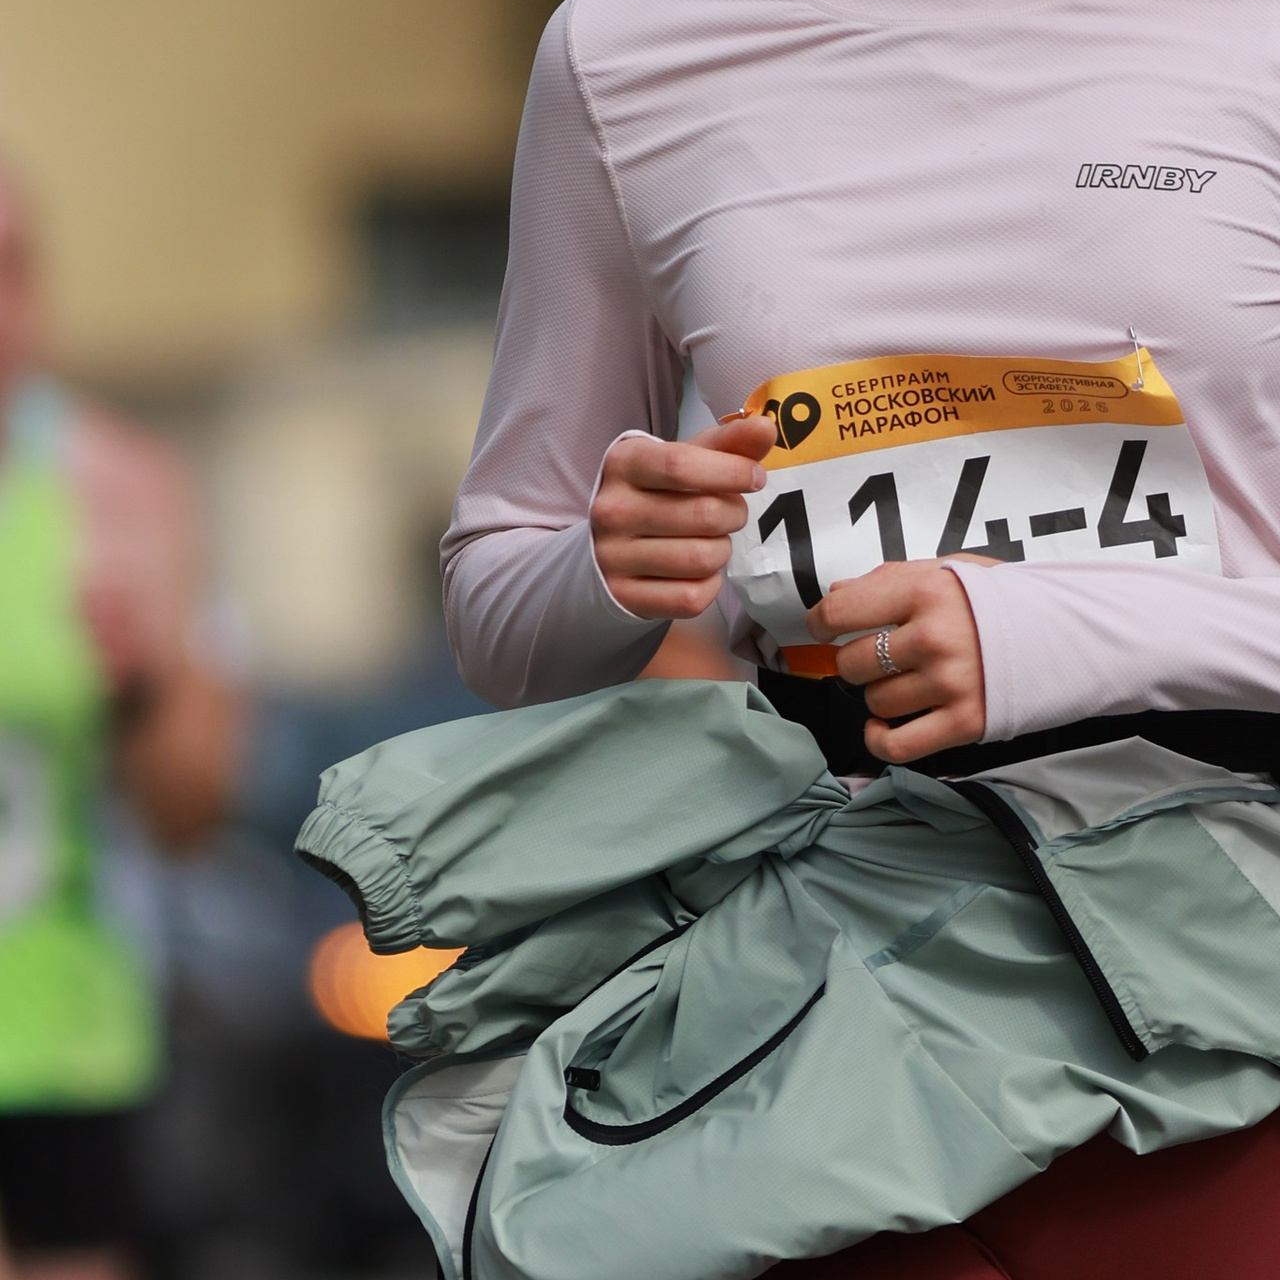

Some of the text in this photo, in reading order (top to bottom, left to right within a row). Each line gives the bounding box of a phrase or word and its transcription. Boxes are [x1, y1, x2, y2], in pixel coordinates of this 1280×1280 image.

[1075, 163, 1218, 194] IRNBY
[831, 369, 951, 399] СБЕРПРАЙМ
[1013, 374, 1116, 389] КОРПОРАТИВНАЯ
[1016, 382, 1077, 393] ЭСТАФЕТА
[834, 384, 997, 421] МОСКОВСКИЙ
[1042, 398, 1109, 414] 2026
[838, 405, 960, 441] МАРАФОН
[757, 439, 1188, 610] 114-4
